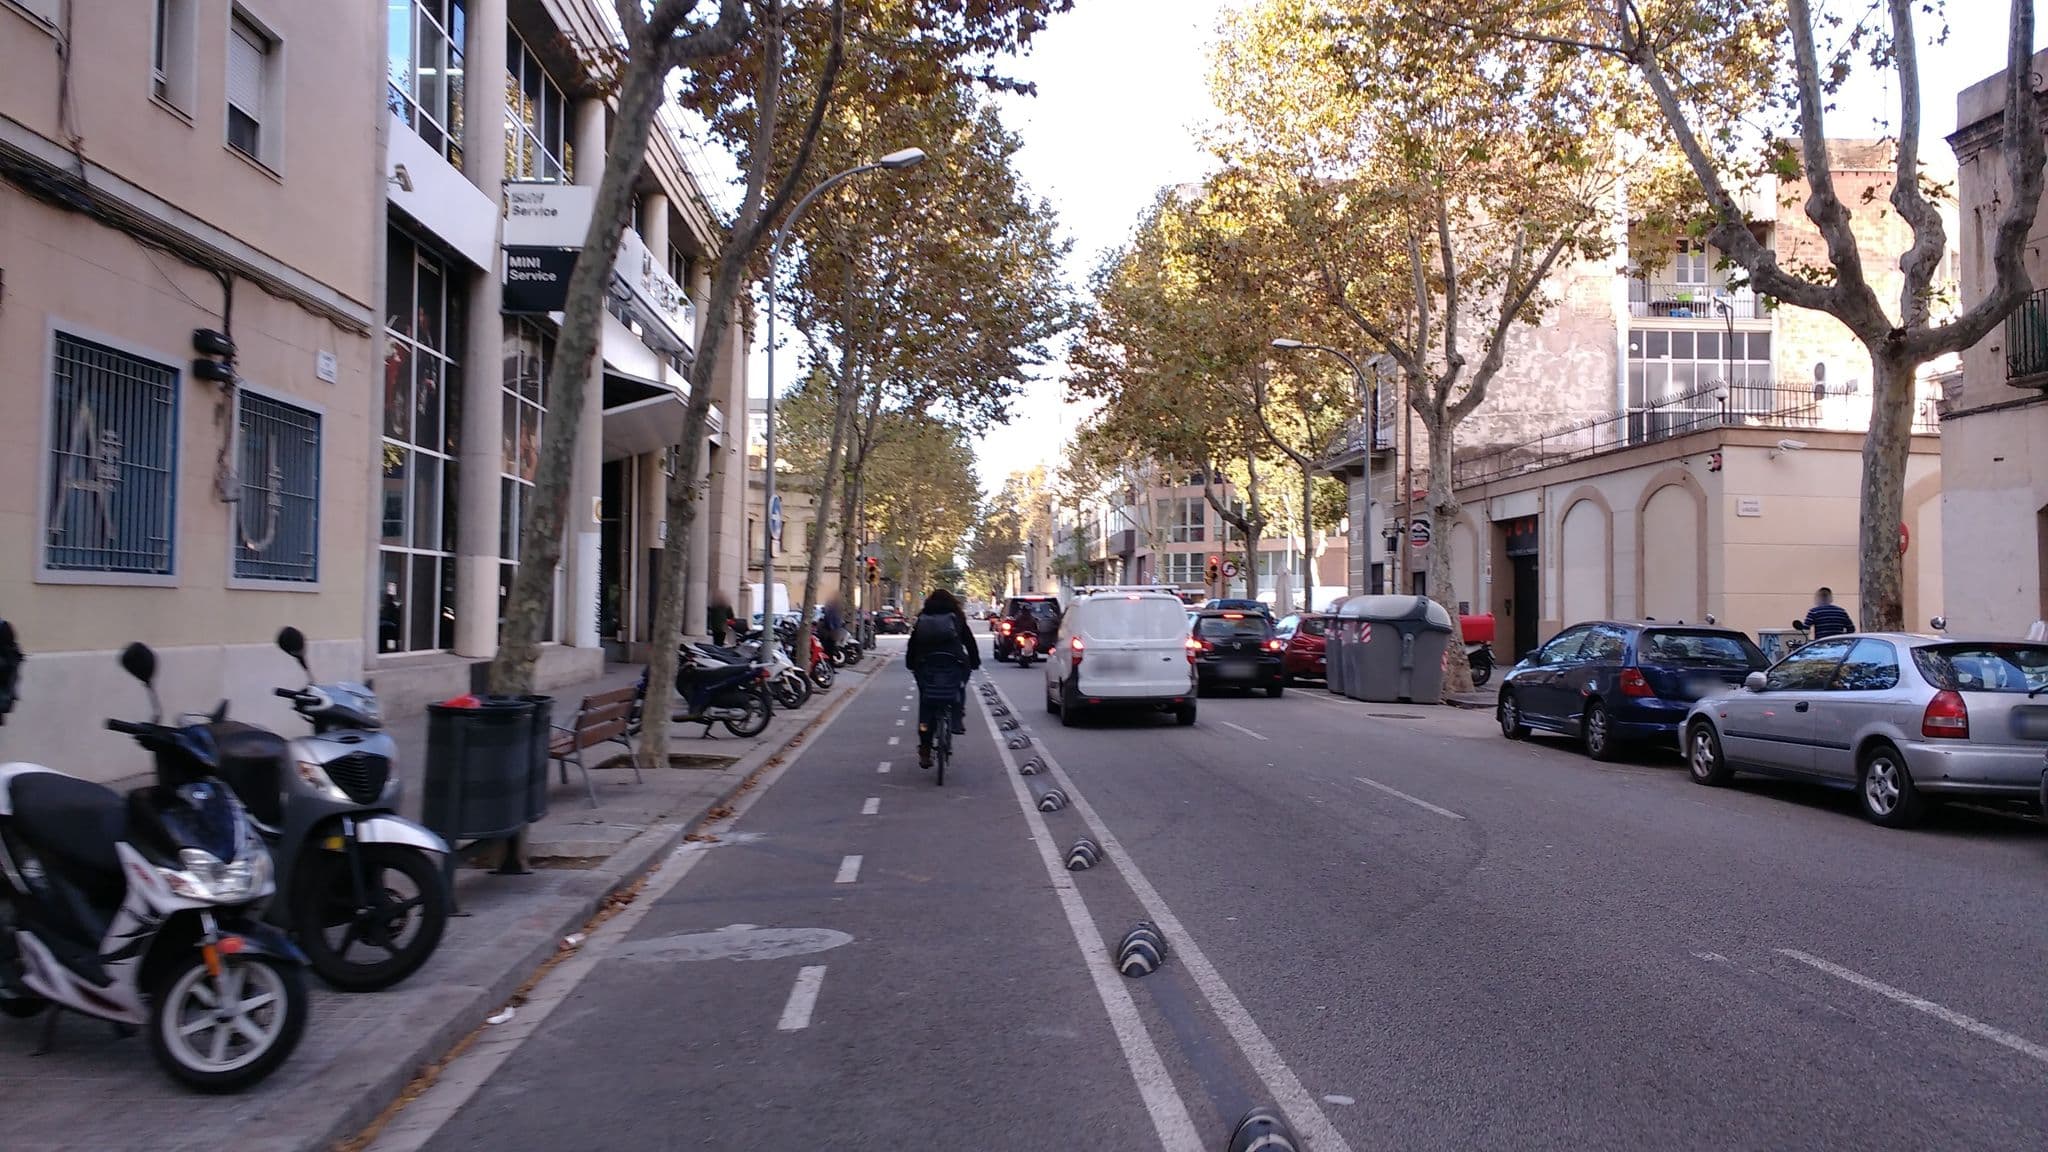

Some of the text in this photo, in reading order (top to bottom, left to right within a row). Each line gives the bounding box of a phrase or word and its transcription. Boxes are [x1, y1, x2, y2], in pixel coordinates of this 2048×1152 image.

[512, 205, 558, 216] Service
[509, 256, 541, 268] MINI
[509, 269, 557, 281] Service
